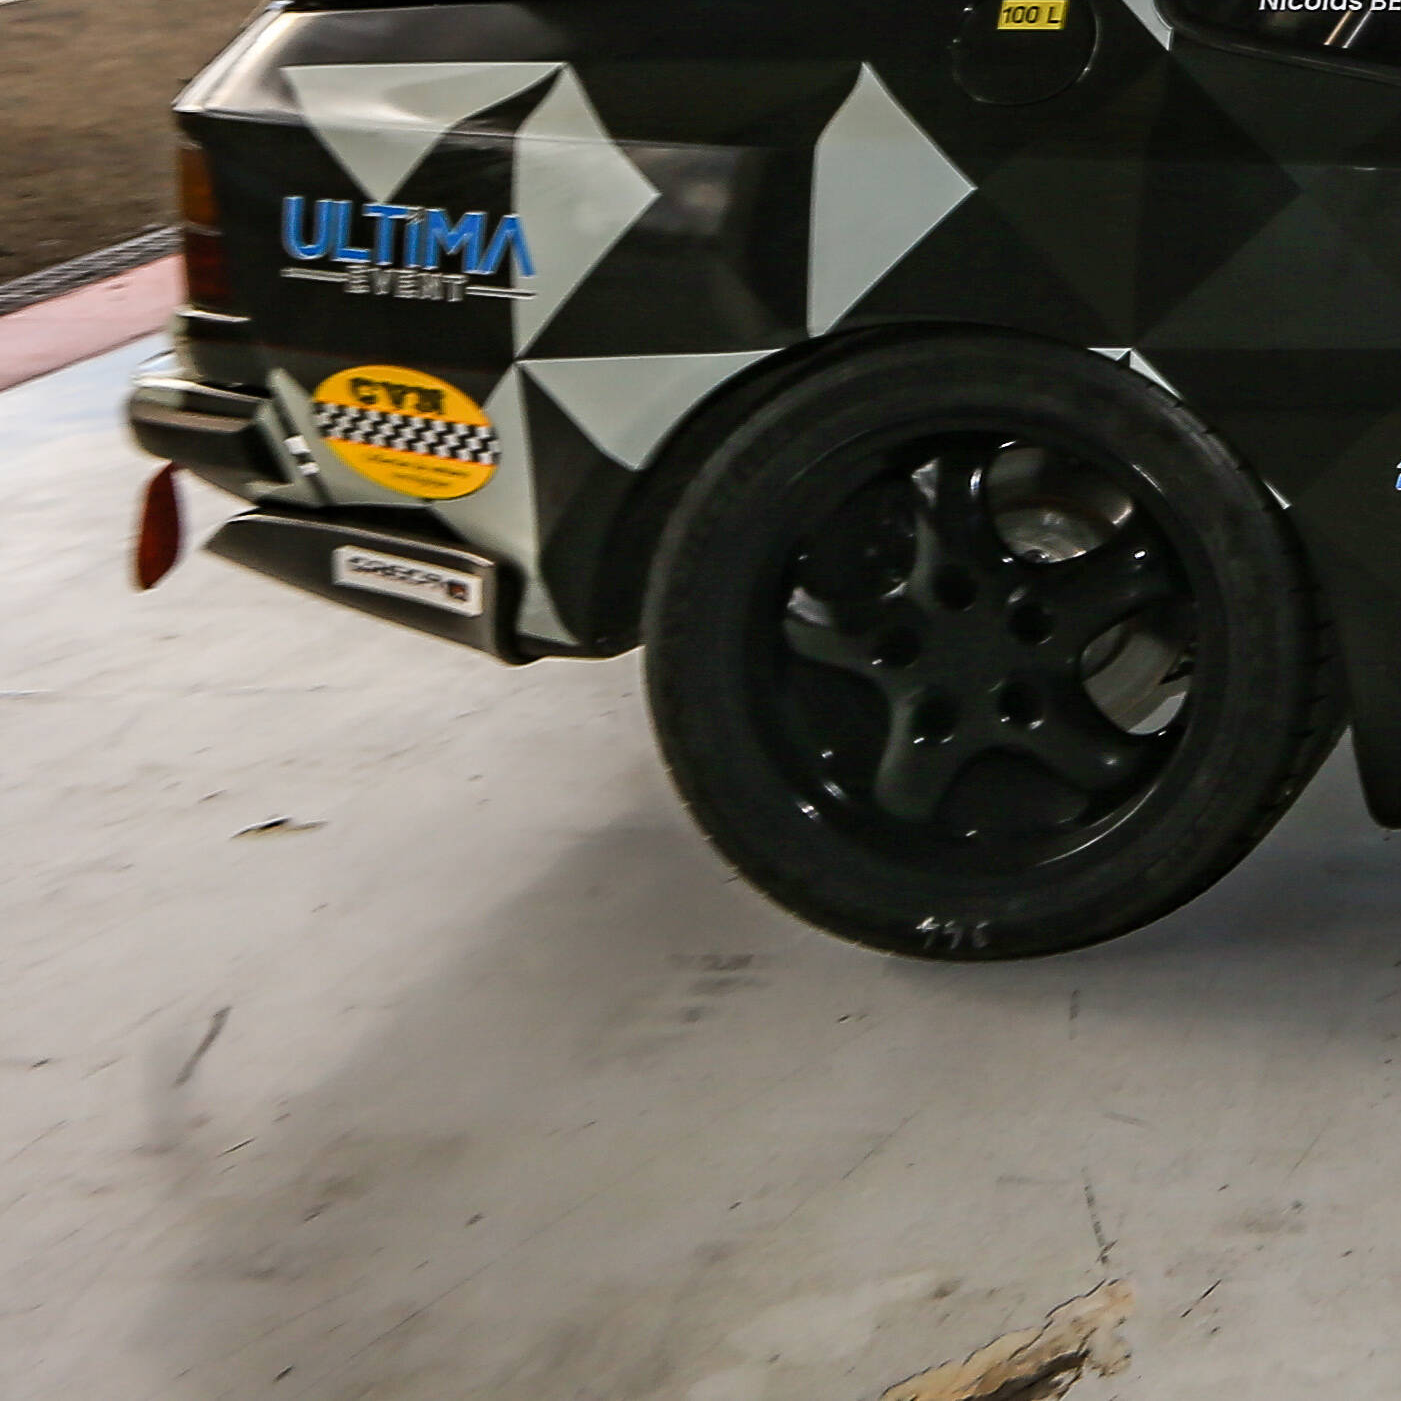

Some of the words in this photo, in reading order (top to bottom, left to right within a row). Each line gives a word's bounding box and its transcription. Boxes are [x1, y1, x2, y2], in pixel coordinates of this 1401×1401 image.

[1002, 6, 1040, 23] 100
[1047, 6, 1061, 23] L
[281, 195, 537, 278] ULTIMA
[343, 265, 469, 302] EVENT
